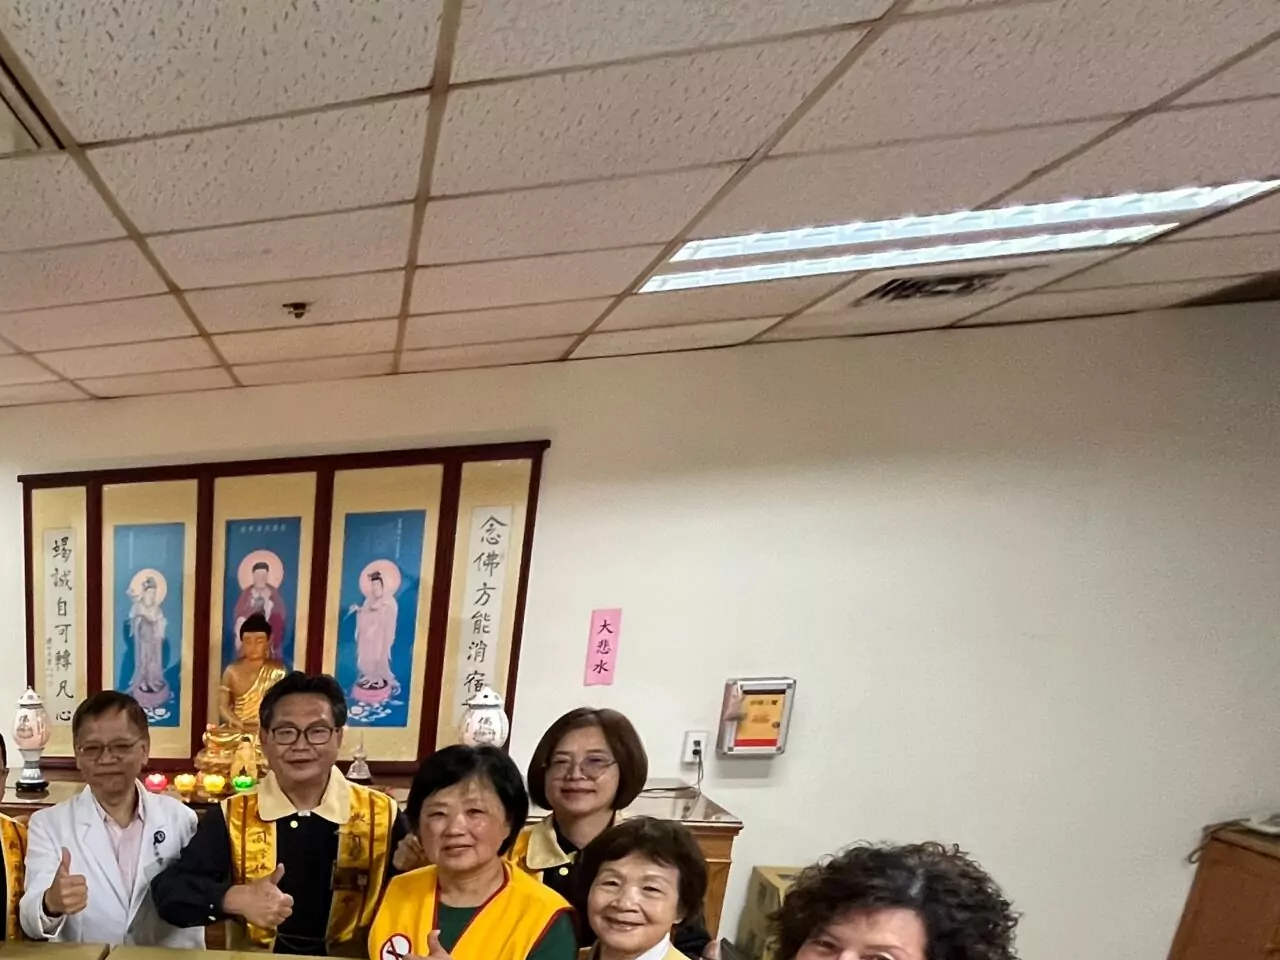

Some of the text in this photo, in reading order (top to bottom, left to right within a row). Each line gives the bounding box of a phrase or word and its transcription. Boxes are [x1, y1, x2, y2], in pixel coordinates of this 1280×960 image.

[461, 516, 508, 706] 念佛方能消宿
[593, 619, 614, 674] 大悲水
